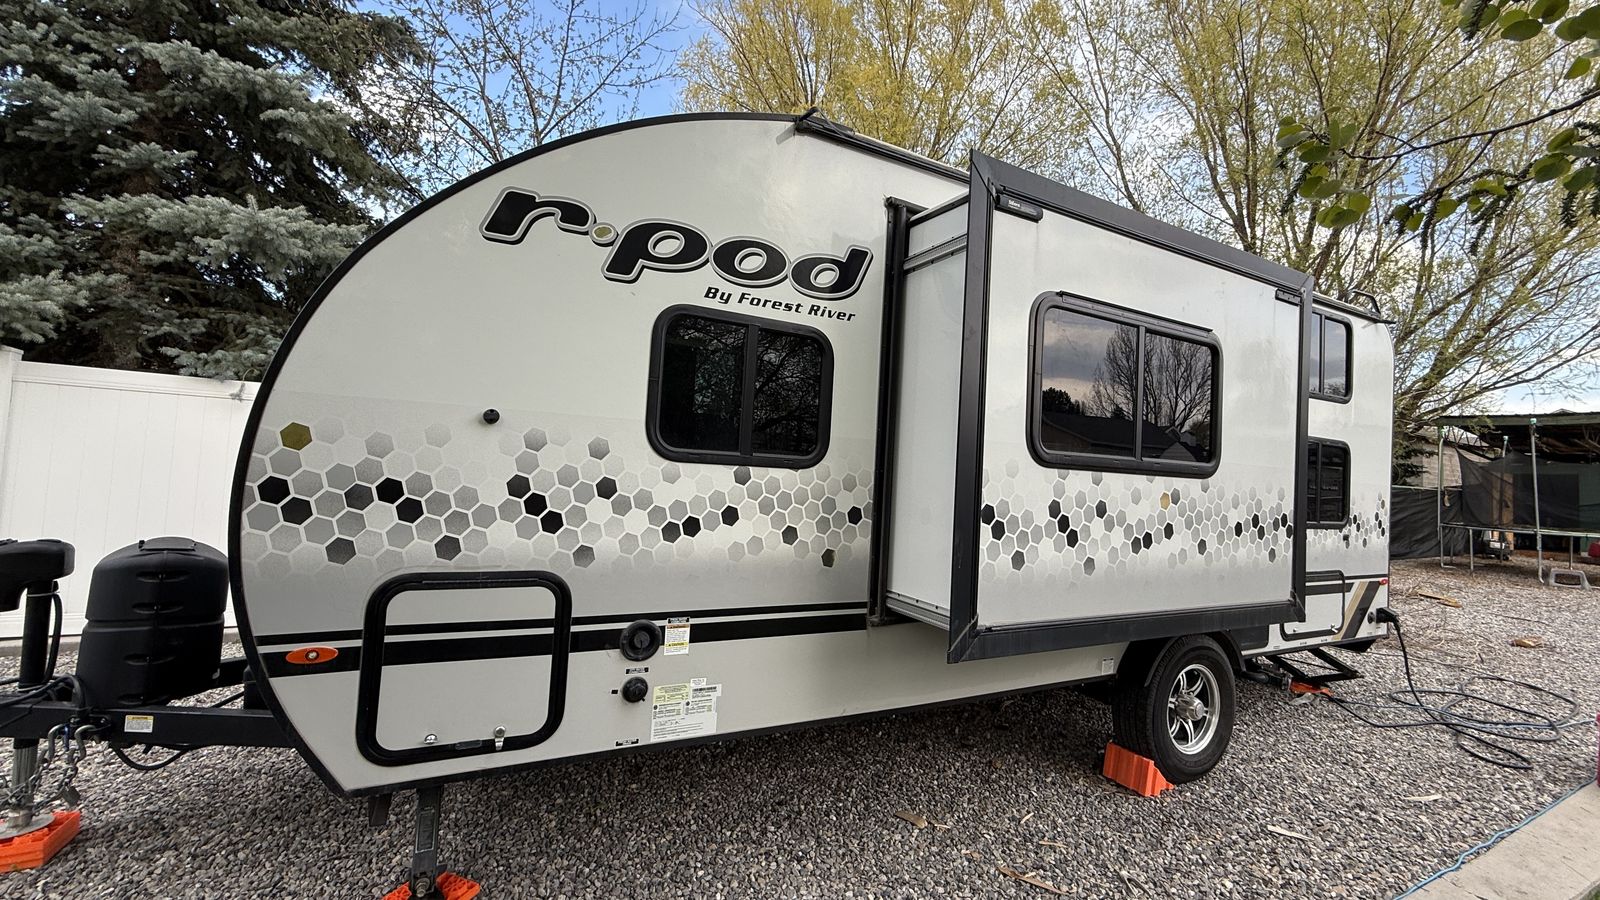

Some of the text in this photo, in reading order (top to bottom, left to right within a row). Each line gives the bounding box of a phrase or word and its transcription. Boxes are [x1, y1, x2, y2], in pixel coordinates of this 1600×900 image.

[703, 286, 856, 322] By Forest River
